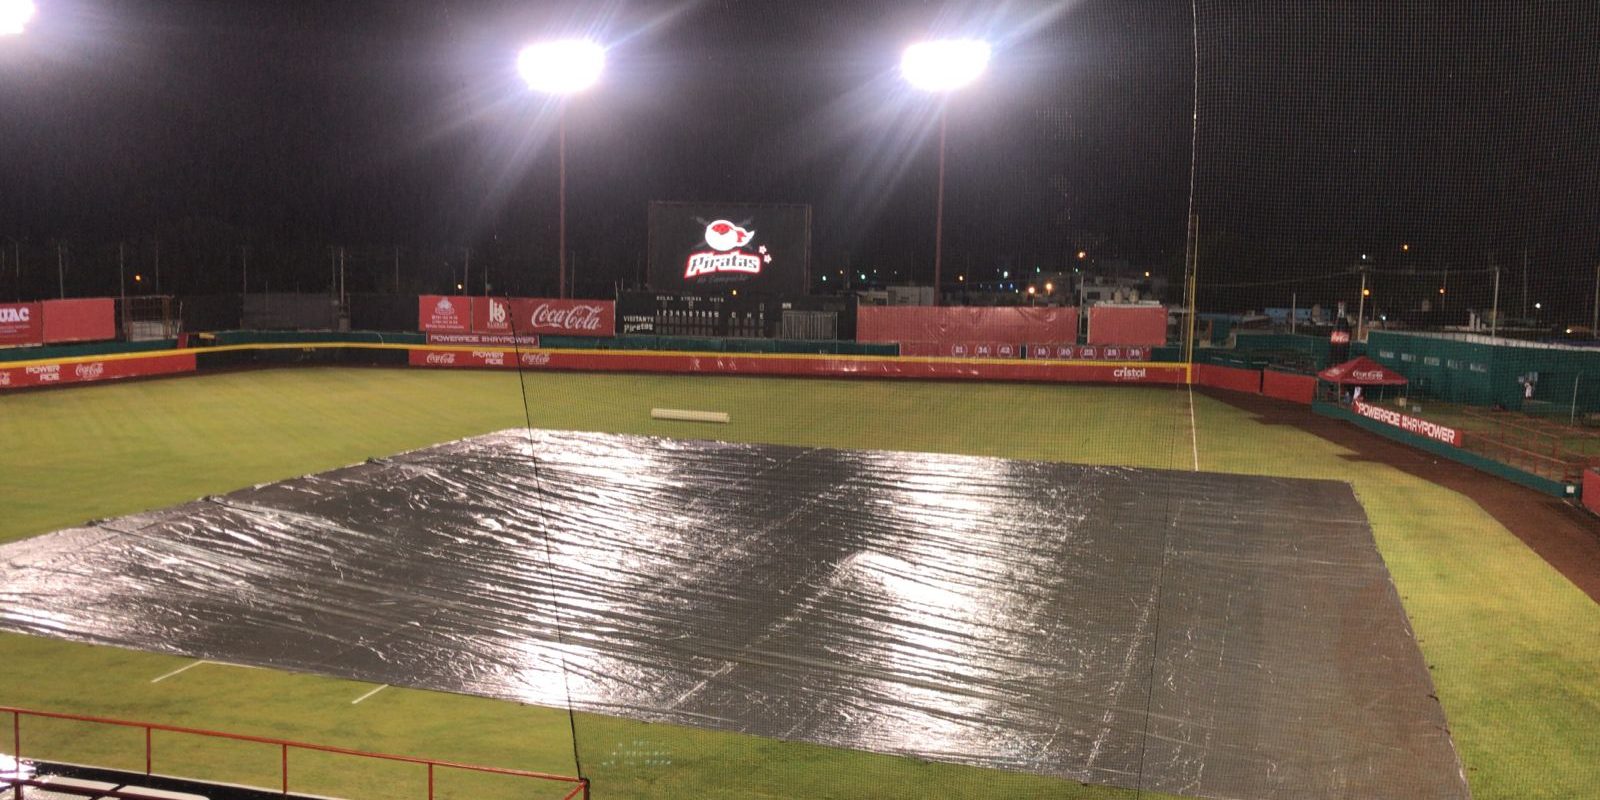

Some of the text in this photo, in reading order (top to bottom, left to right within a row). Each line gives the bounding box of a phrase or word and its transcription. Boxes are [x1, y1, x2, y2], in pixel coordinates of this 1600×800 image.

[687, 252, 759, 275] Piratas
[531, 303, 602, 330] Coca-Cola
[430, 335, 480, 343] POWERADE
[472, 351, 504, 359] POWER
[26, 364, 60, 374] POWER
[1114, 365, 1146, 377] cristal
[1358, 402, 1455, 443] POWERADE #HAYPOWER
